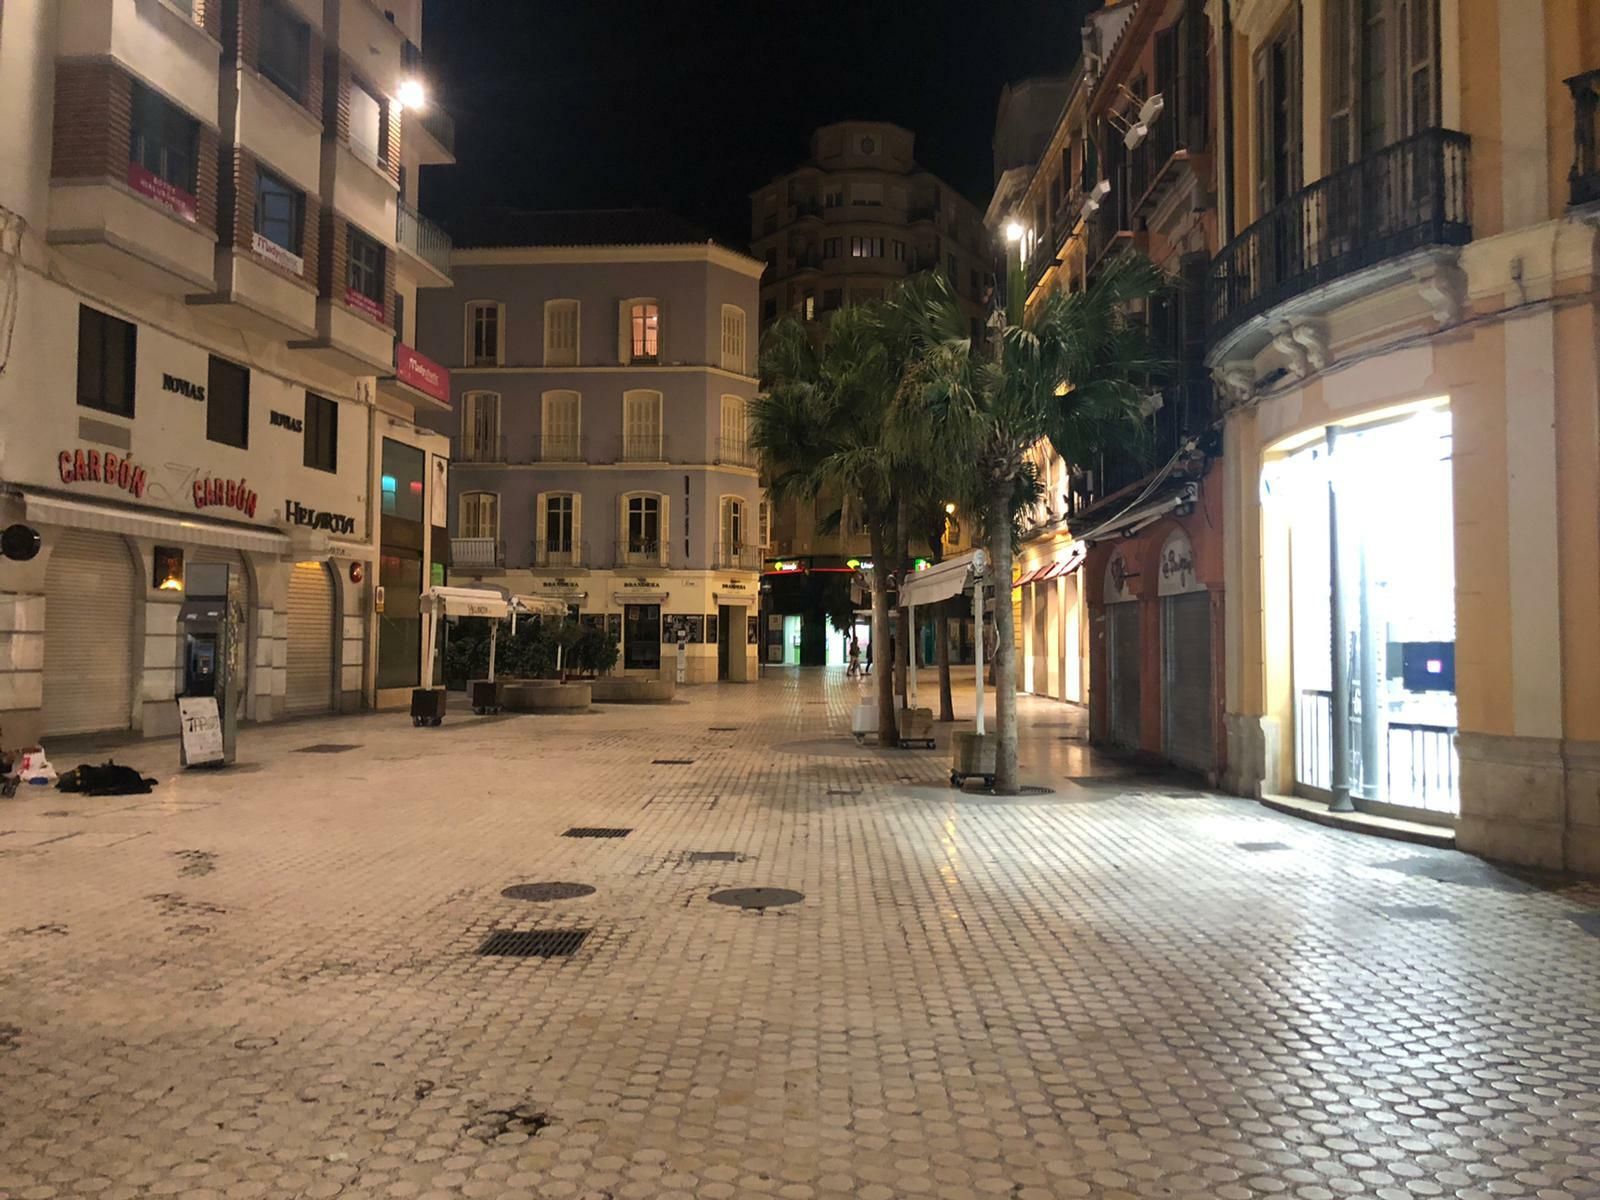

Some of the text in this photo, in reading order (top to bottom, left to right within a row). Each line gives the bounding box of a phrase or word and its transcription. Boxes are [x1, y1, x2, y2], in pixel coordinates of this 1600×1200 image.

[162, 373, 205, 402] NOVIAS
[270, 410, 303, 433] NOVIAS
[59, 449, 148, 498] CARBÓN
[192, 477, 258, 518] CARBÓN
